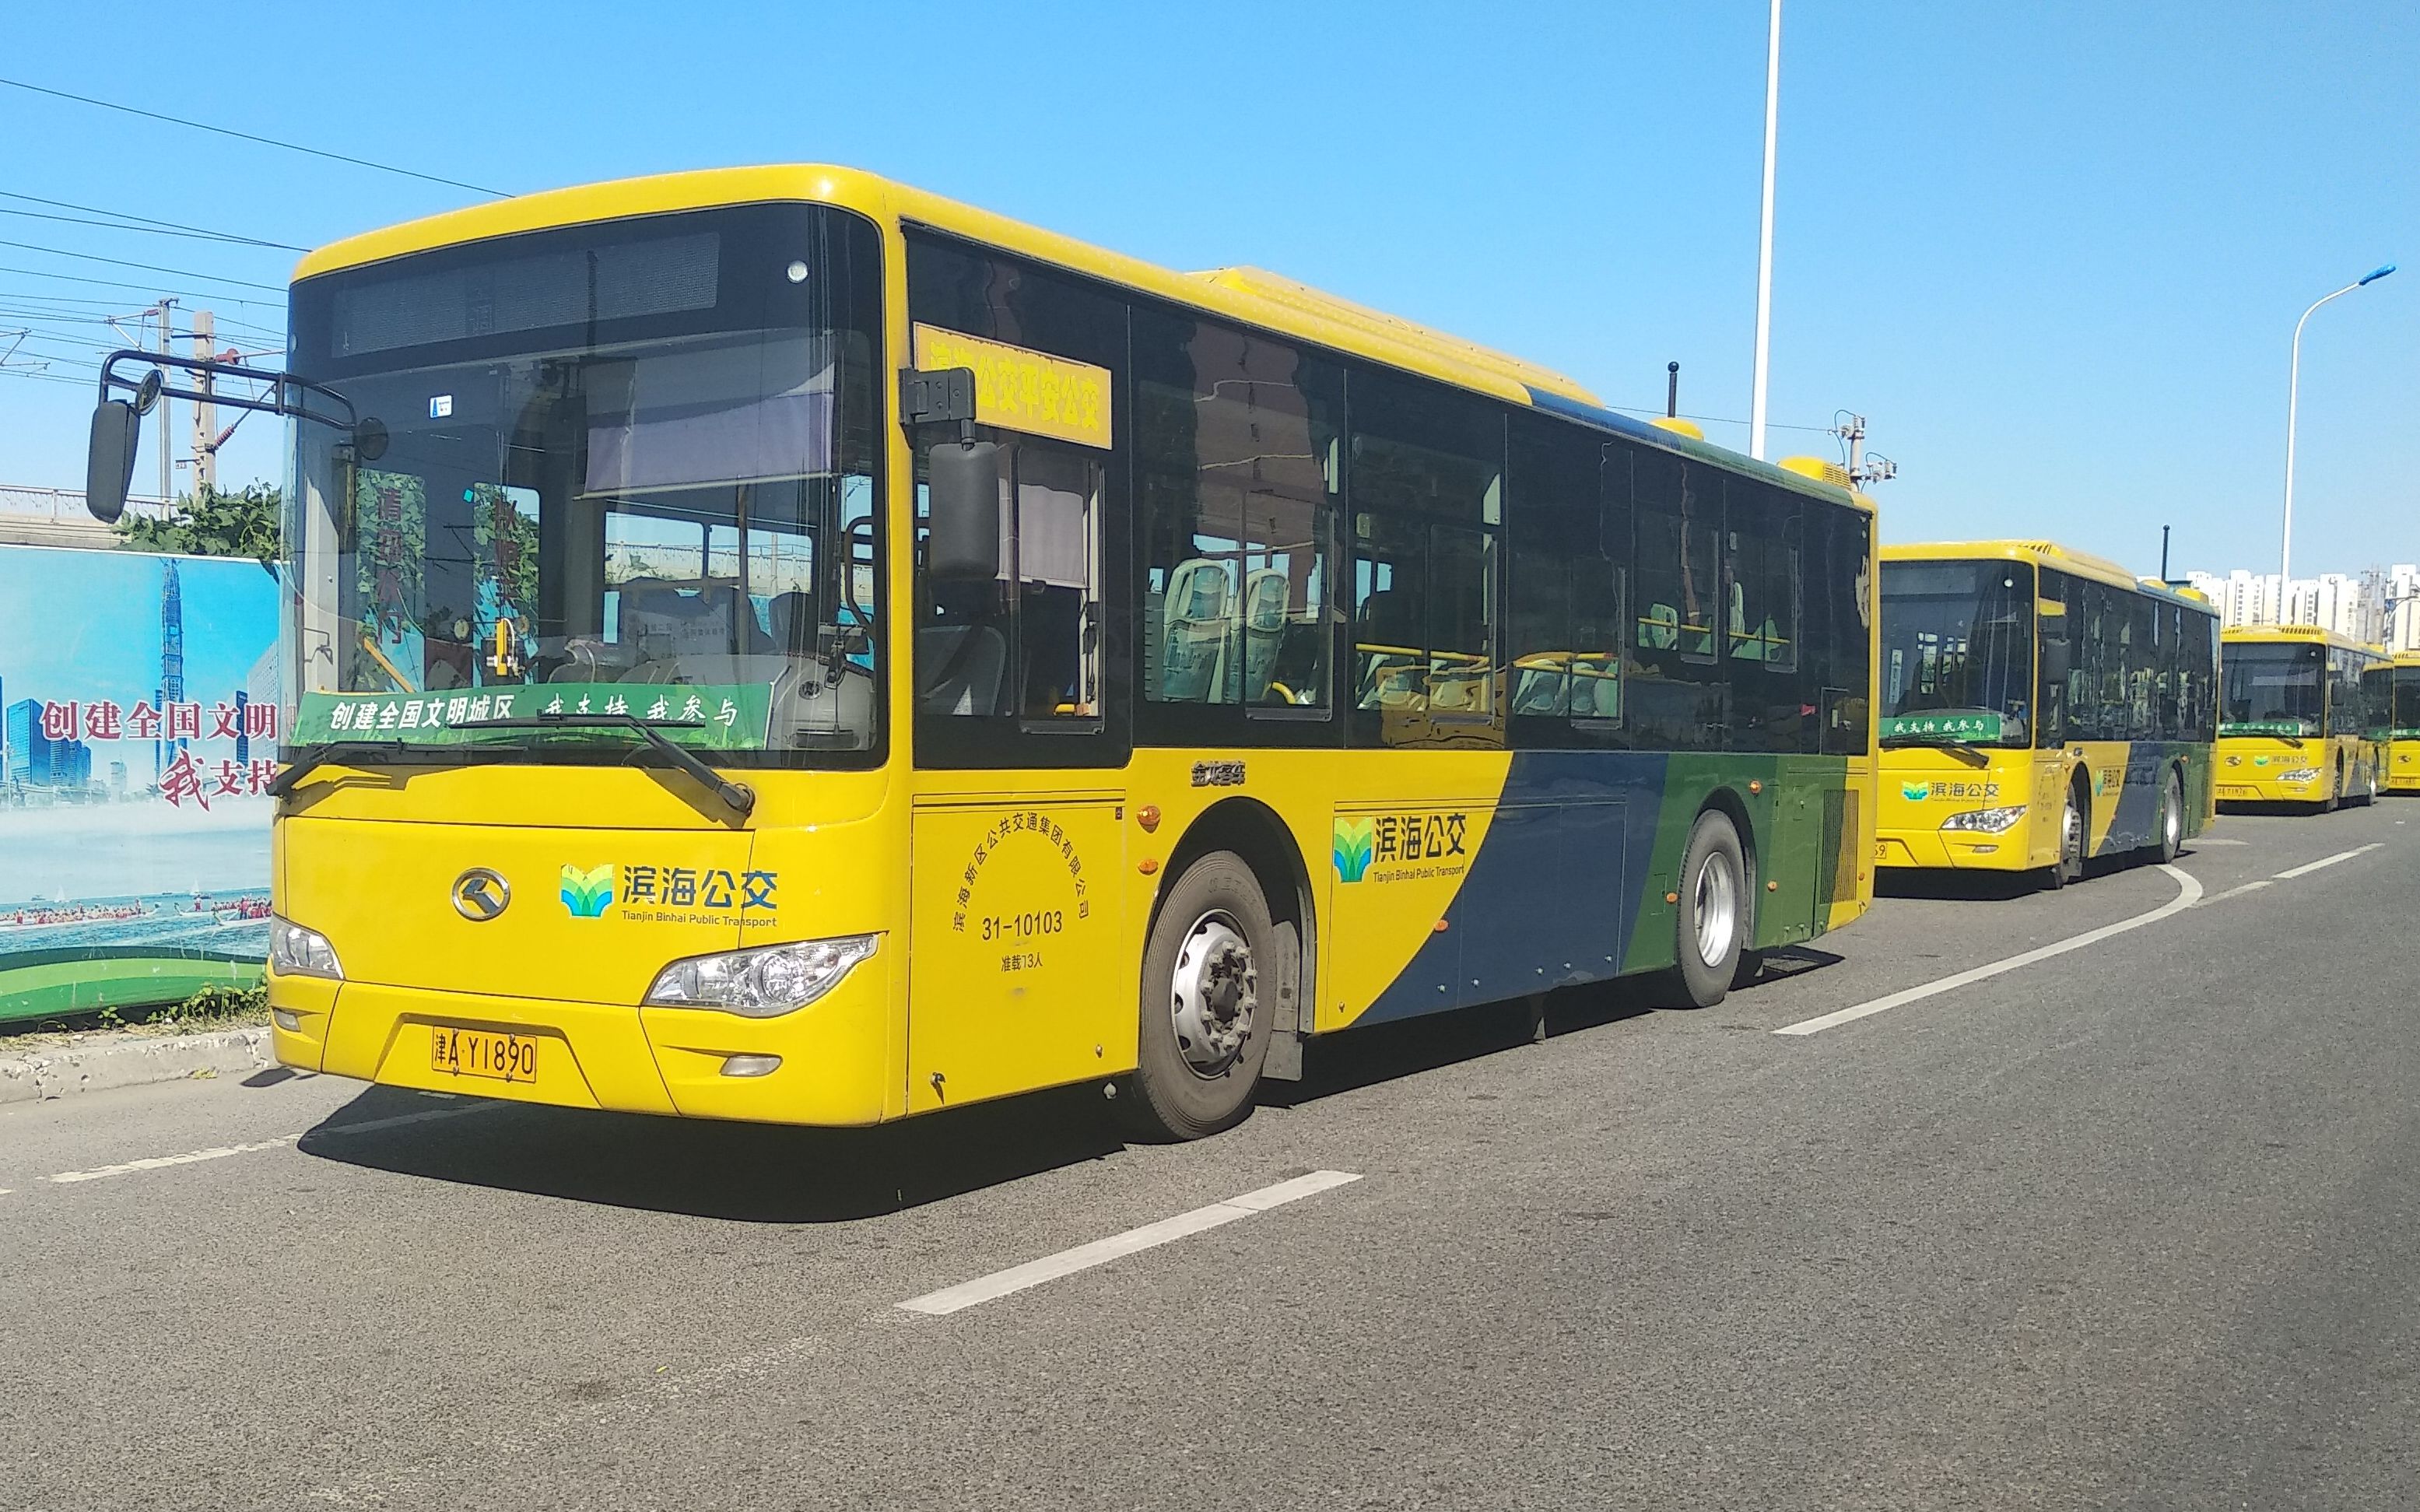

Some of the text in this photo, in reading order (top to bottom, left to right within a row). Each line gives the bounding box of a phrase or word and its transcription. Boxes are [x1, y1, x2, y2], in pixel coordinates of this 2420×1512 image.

[41, 700, 277, 740] 创建全国文明
[330, 694, 515, 731] 创建全国文明城区
[545, 692, 738, 727] 我支持 我参与
[1894, 719, 1984, 733] 我支持 我参与
[158, 747, 278, 812] 我支持
[1931, 782, 1999, 797] 滨海公交
[1374, 812, 1466, 864] 滨海公交
[623, 865, 777, 910] 滨海公交
[953, 812, 1089, 932] 滨海新区公共交通集团有限公司
[1373, 865, 1464, 883] Tianjin Binhai Public Transport
[623, 910, 777, 928] Tianjin Binhai Public Transport
[982, 910, 1062, 941] 31-10103
